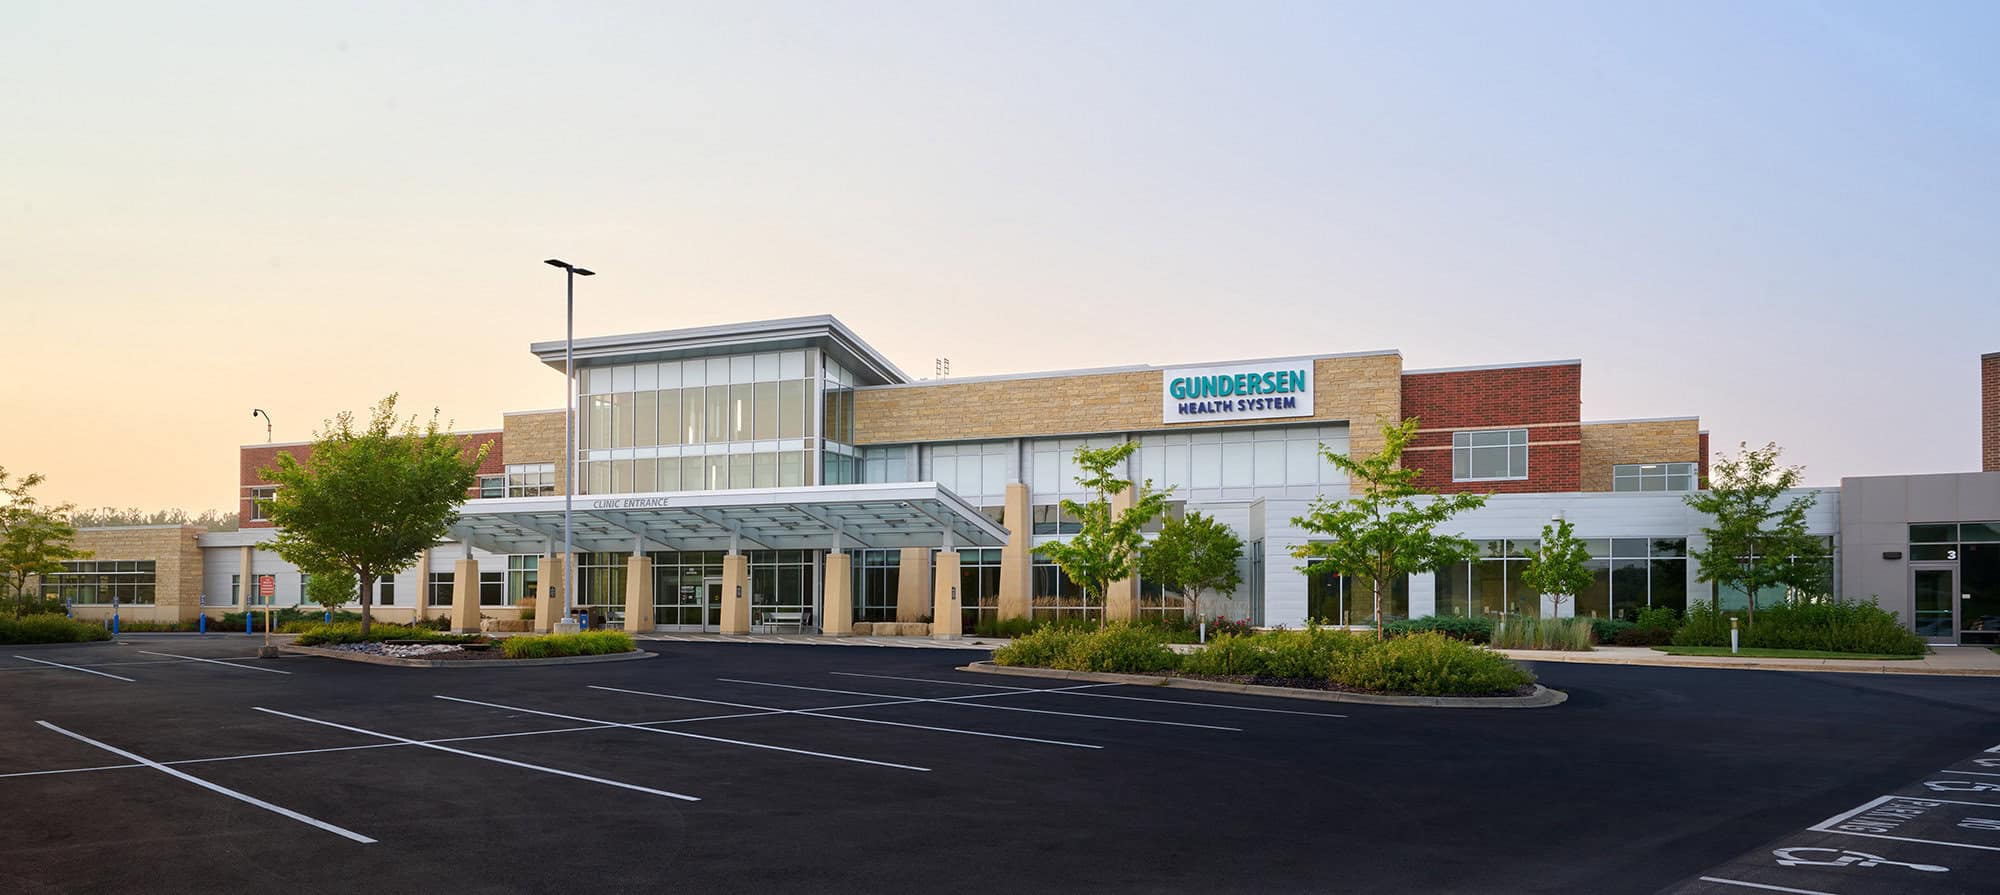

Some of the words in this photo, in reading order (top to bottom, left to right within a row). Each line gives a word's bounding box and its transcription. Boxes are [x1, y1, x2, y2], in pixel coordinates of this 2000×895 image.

[1169, 369, 1306, 400] GUNDERSEN
[1178, 400, 1233, 415] HEALTH
[1238, 396, 1297, 412] SYSTEM
[593, 499, 621, 509] CLINIC
[623, 496, 670, 508] ENTRANCE
[1946, 550, 1957, 560] 3
[1837, 799, 1942, 833] PARKING
